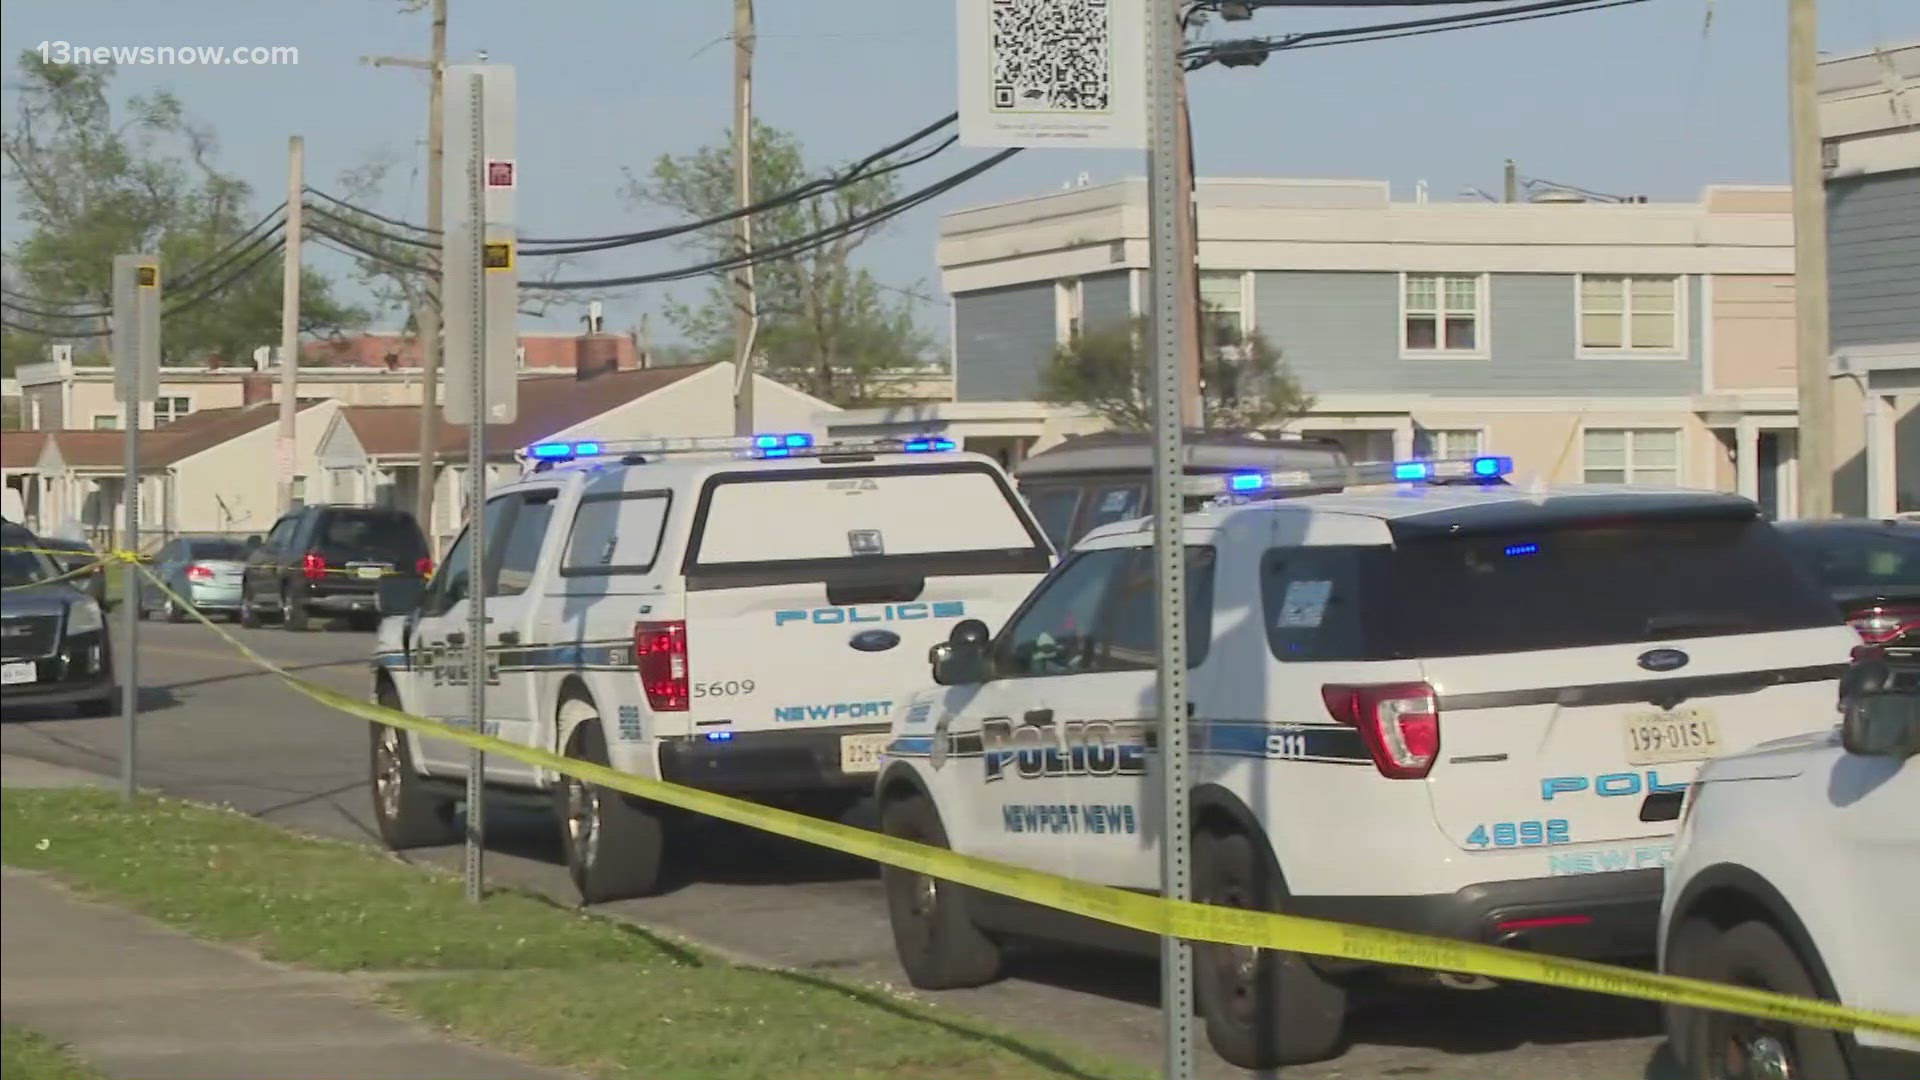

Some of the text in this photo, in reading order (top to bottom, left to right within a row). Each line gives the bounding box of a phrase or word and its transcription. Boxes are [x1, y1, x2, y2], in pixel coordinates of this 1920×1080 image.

[775, 600, 965, 627] POLICE
[693, 680, 756, 698] 5609
[774, 701, 893, 722] NEWPORT
[981, 717, 1152, 785] POLICE
[1264, 734, 1306, 756] 911
[1001, 803, 1137, 834] NEWPORT NEWS
[1467, 819, 1570, 848] 4892
